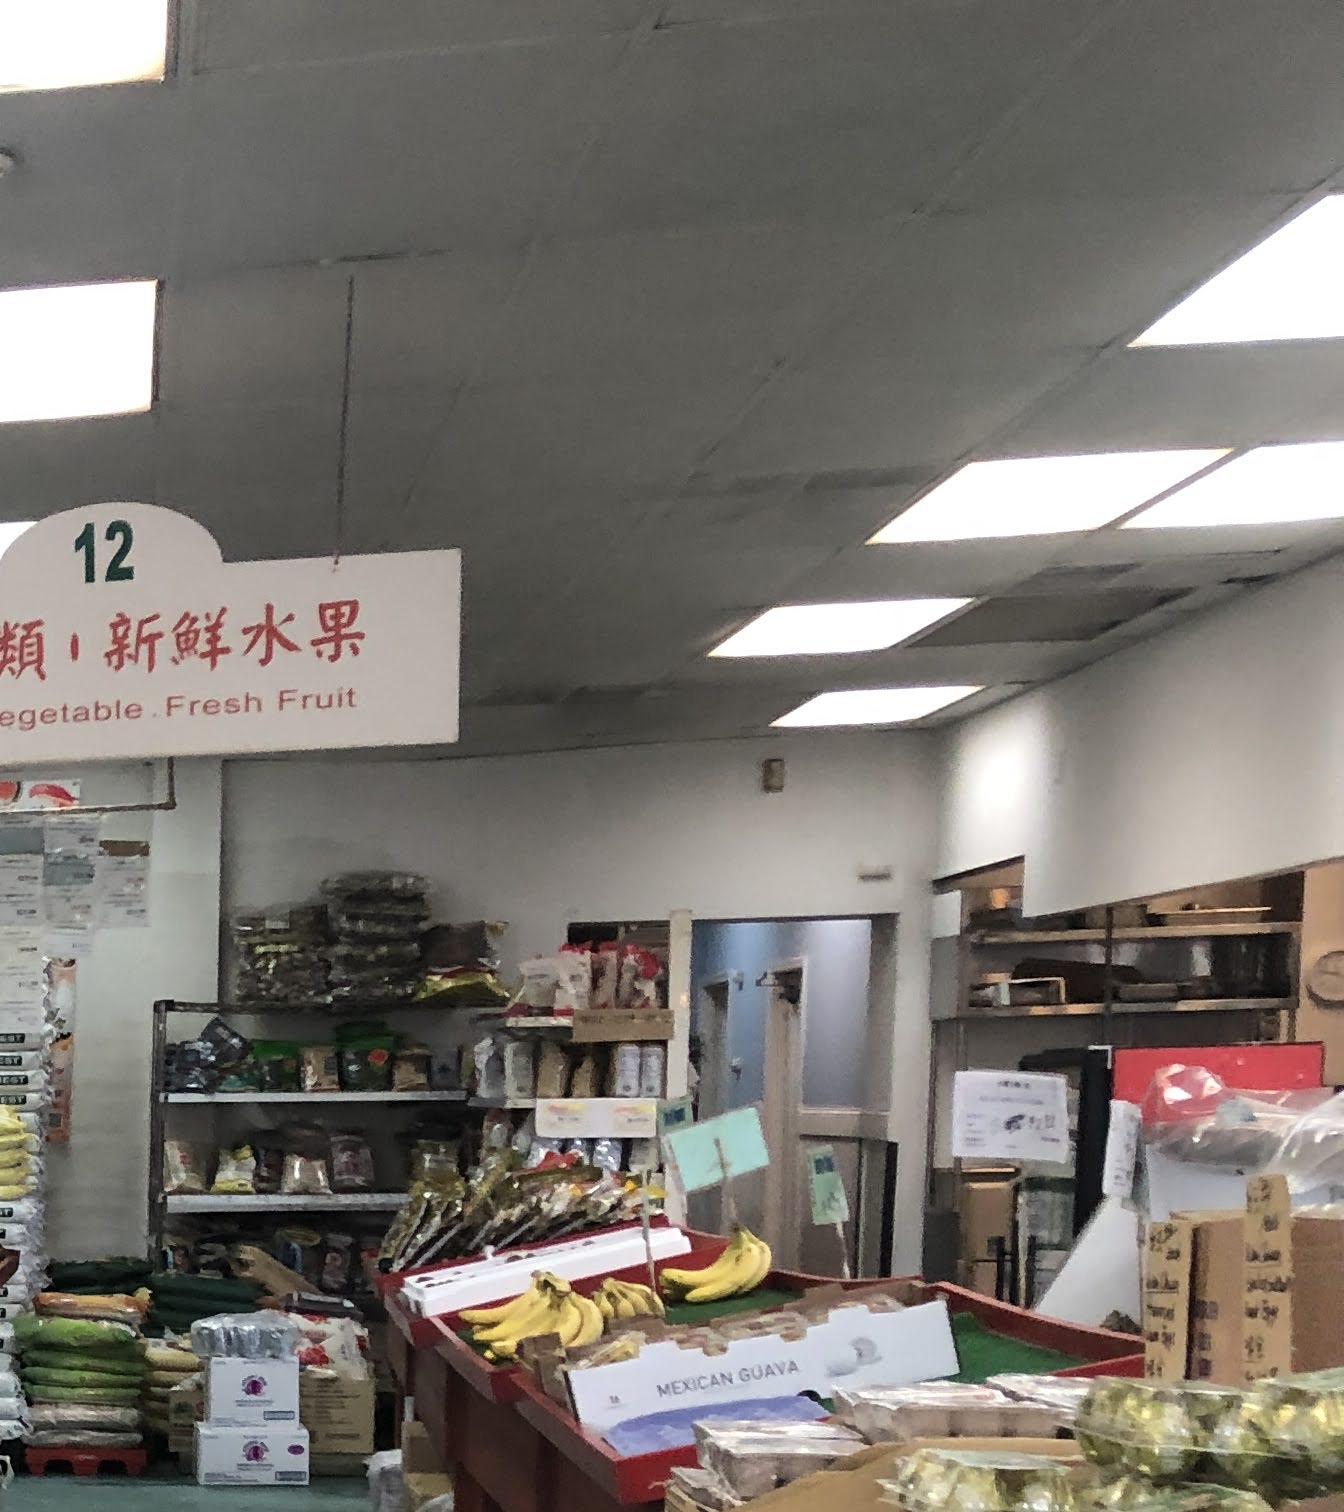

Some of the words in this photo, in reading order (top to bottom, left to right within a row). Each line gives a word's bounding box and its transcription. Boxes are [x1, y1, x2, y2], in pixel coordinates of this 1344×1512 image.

[73, 519, 134, 583] 12
[165, 691, 263, 720] Fresh
[278, 686, 358, 713] Fruit
[656, 1370, 734, 1398] MEXICAN
[738, 1359, 800, 1383] GUAVA
